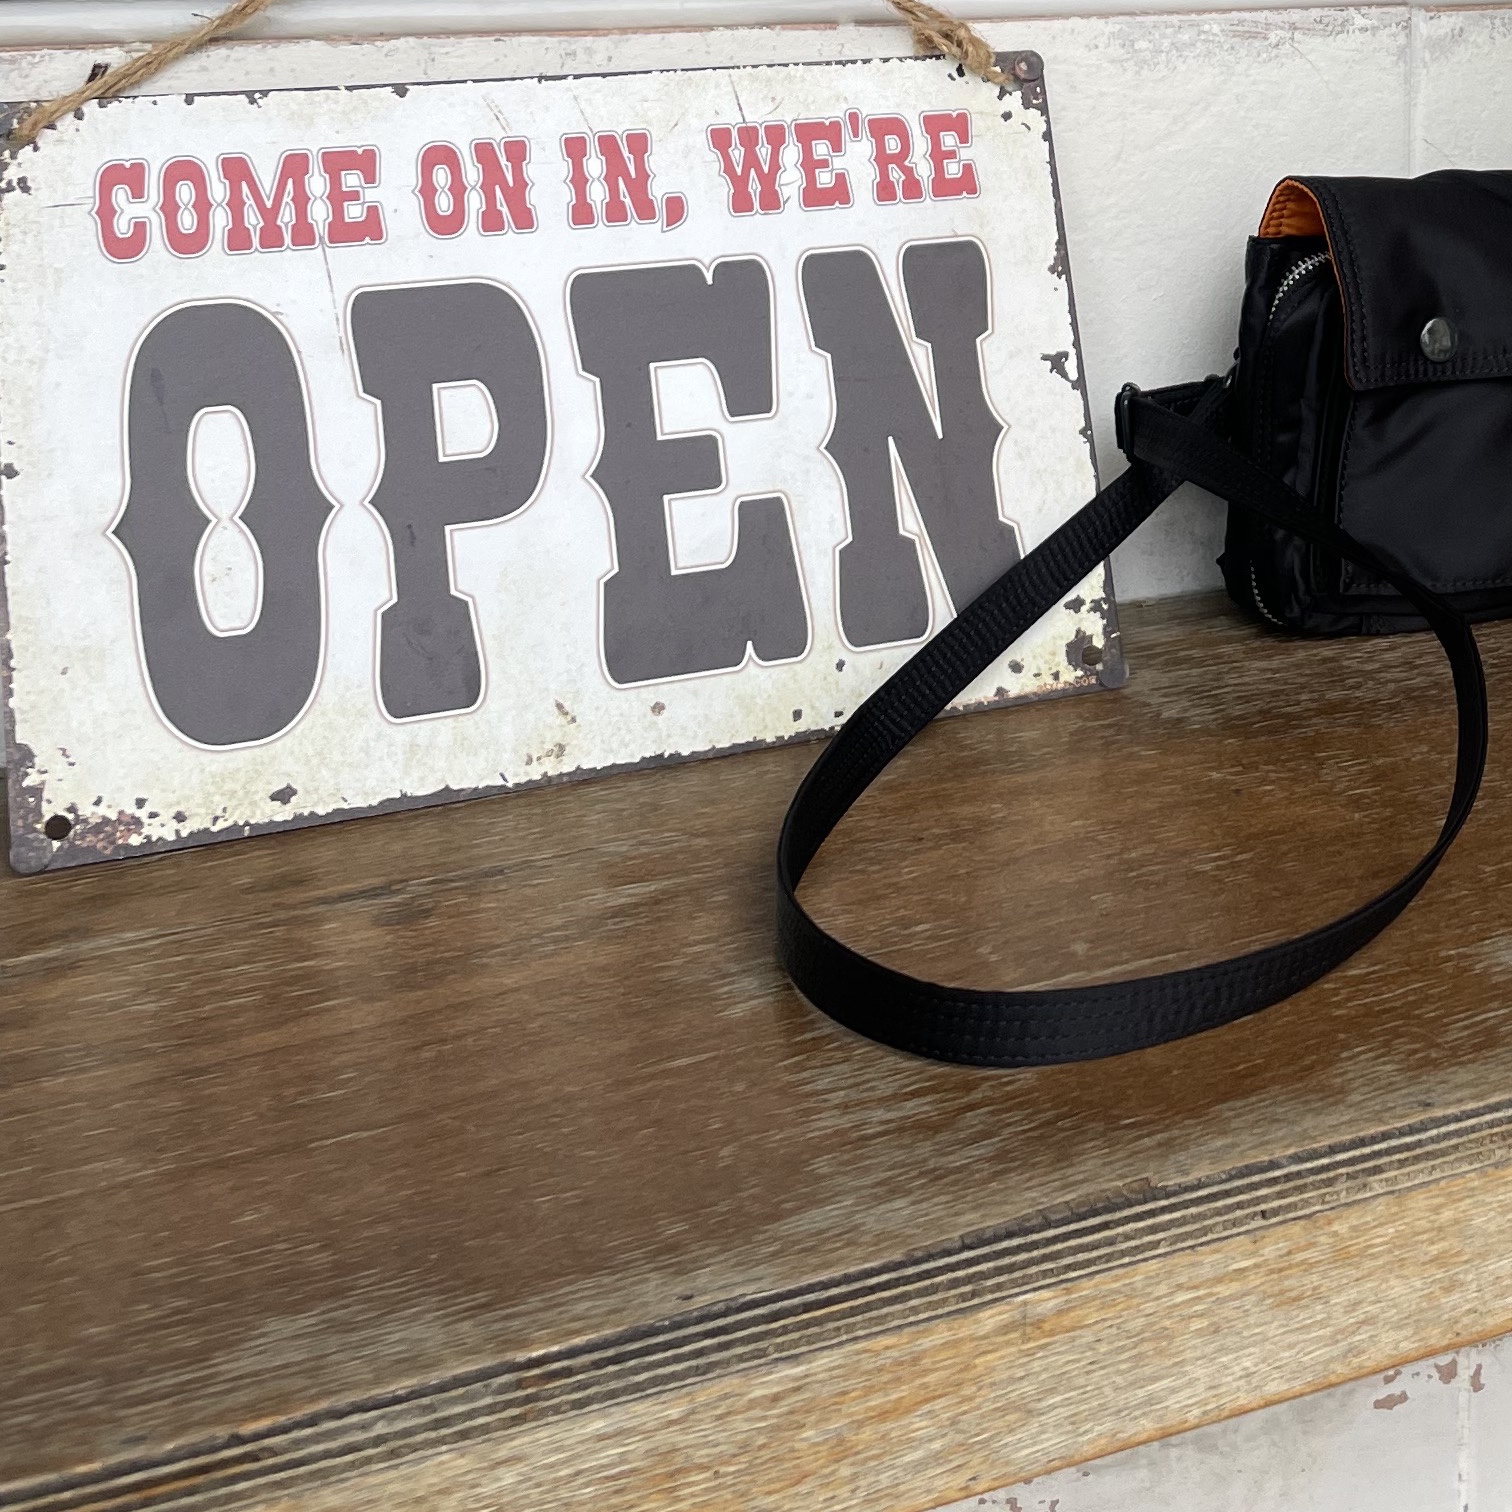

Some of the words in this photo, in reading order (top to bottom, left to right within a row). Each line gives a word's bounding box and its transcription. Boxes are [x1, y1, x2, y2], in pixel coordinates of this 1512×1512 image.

[93, 146, 387, 263] COME
[415, 137, 537, 240] ON
[561, 129, 688, 232] IN,
[707, 109, 982, 217] WE'RE
[106, 236, 1026, 751] OPEN
